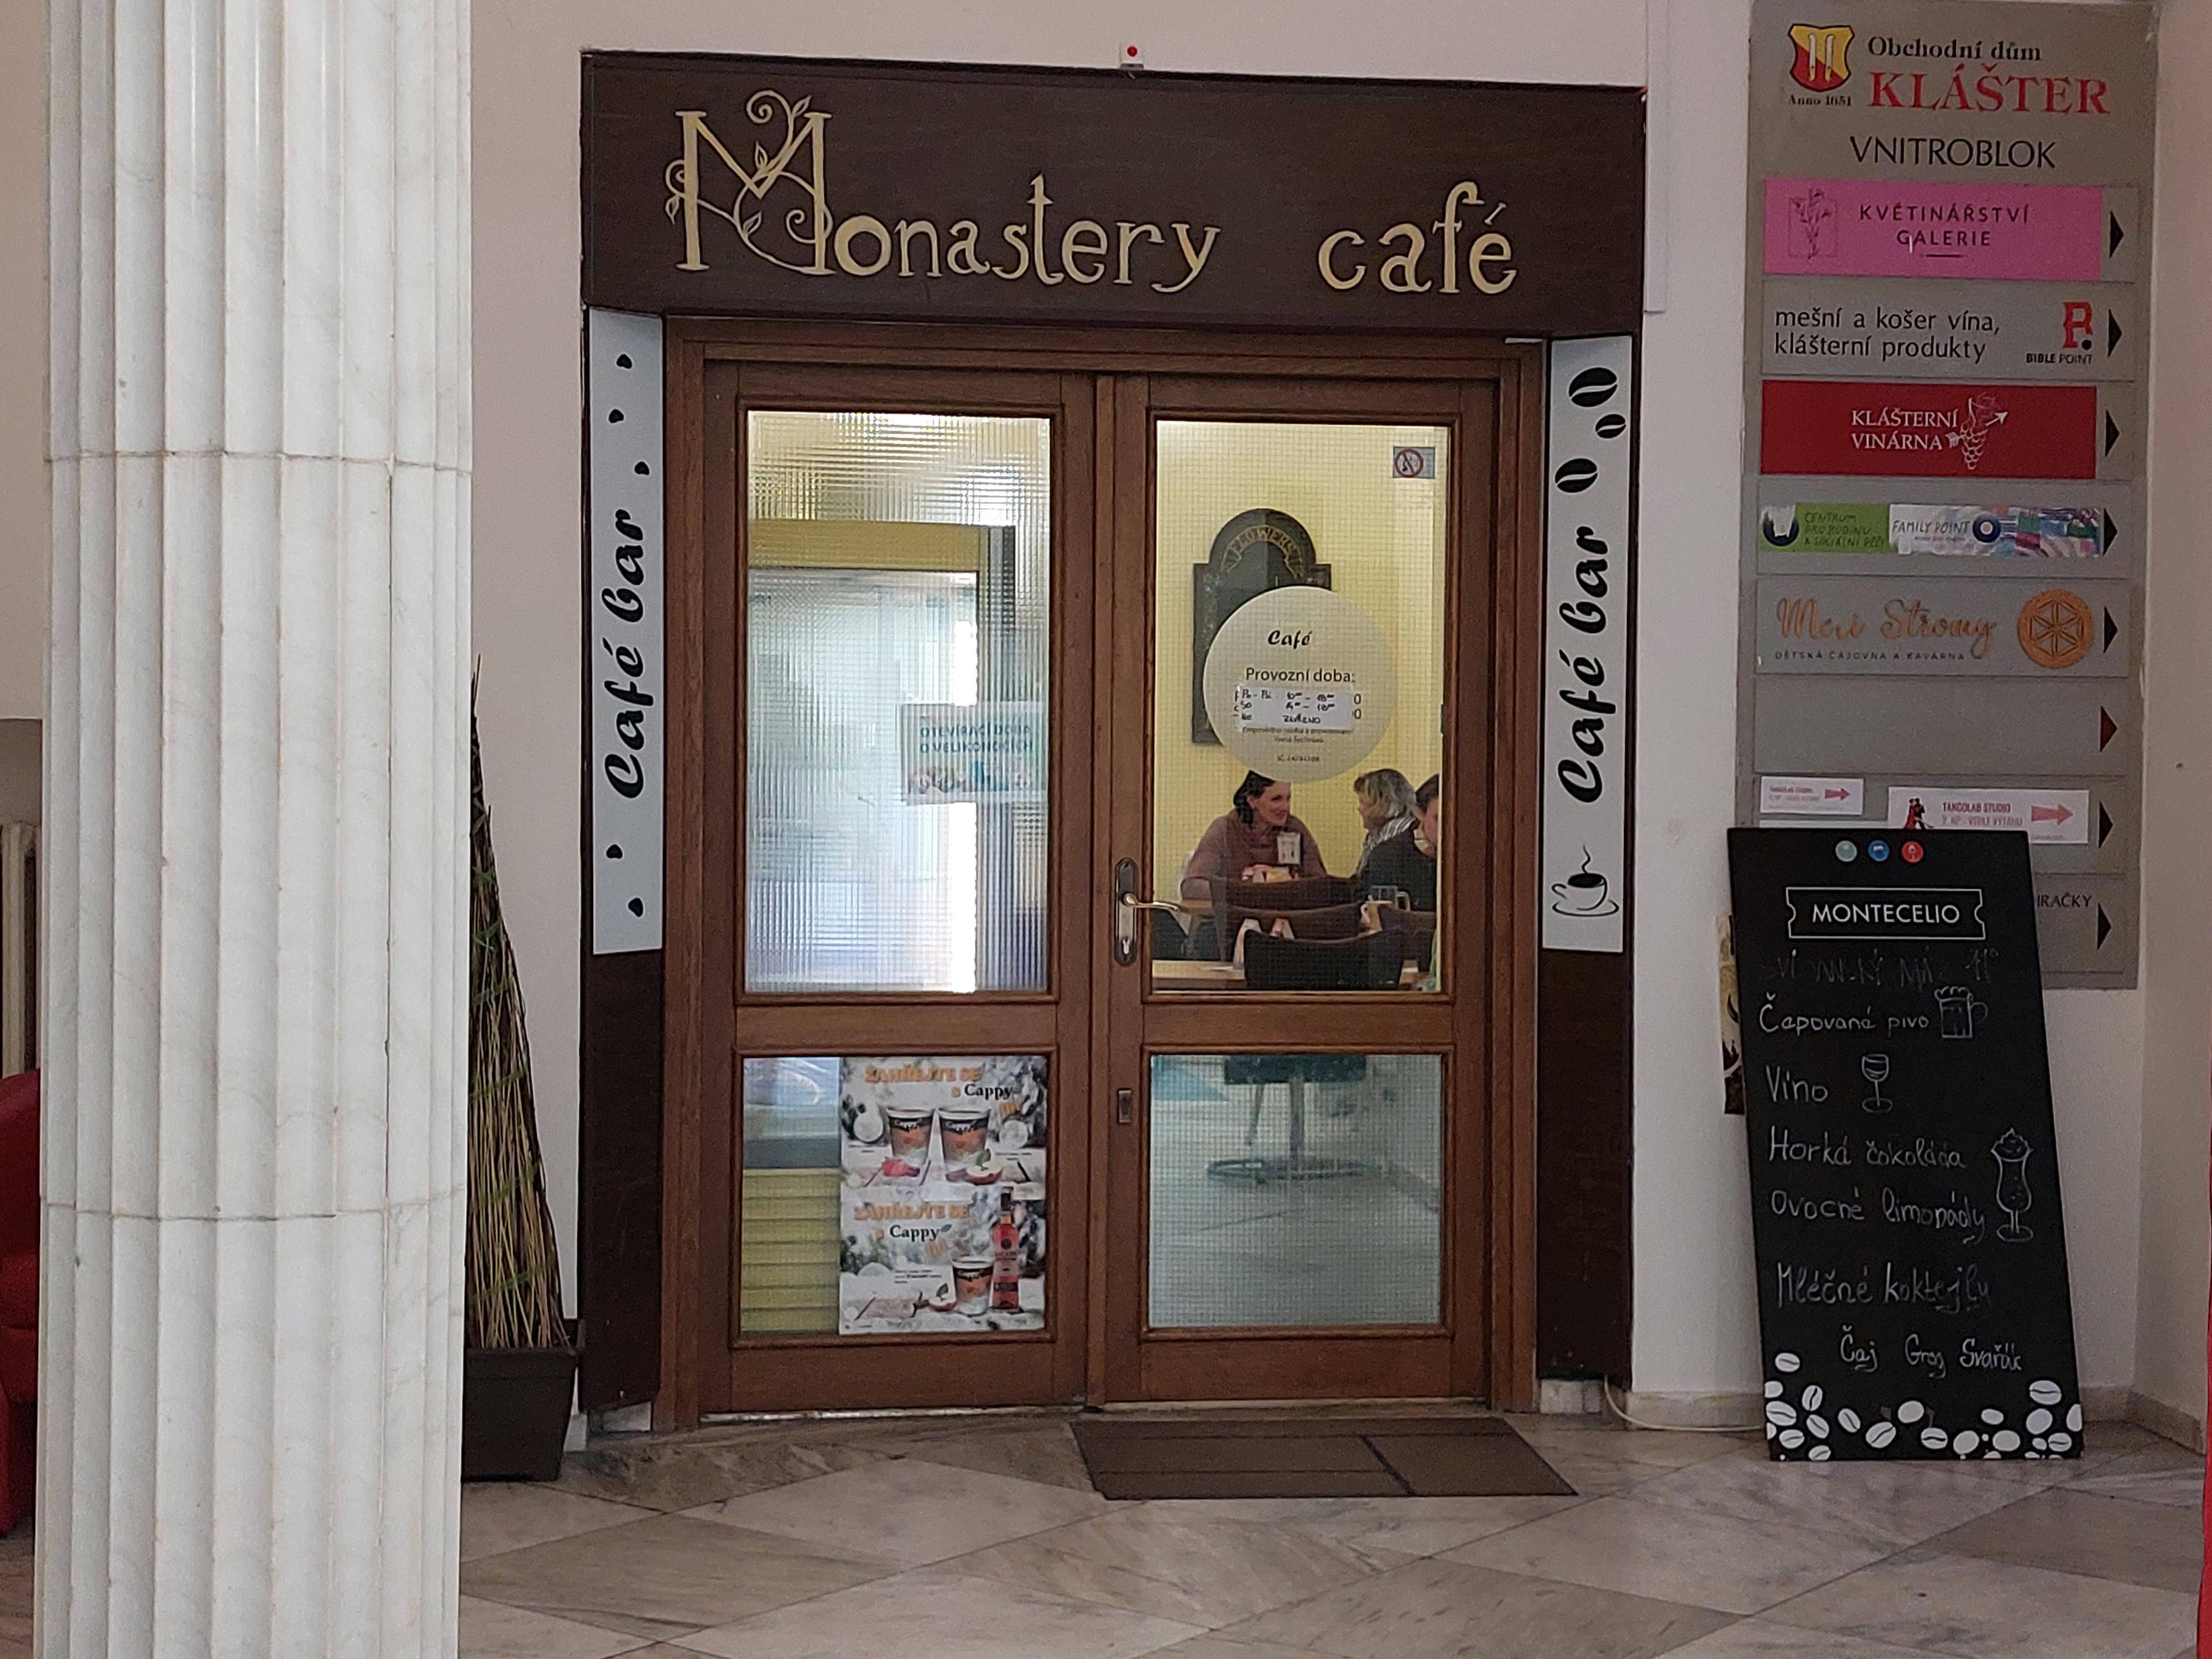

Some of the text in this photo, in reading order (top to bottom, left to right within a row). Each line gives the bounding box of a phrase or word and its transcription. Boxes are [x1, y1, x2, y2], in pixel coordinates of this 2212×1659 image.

[1867, 35, 2041, 61] Obchodní dům
[1788, 94, 1821, 106] Anno
[1867, 62, 2110, 114] KLÁŠTER
[1850, 136, 2056, 168] VNITROBLOK
[665, 90, 1517, 294] Monastery café
[1860, 202, 2029, 225] KVĚTINÁŘSTVÍ
[1897, 230, 1991, 247] GALERIE
[1775, 306, 2000, 335] mešní a košer vína,
[1775, 333, 1986, 363] klášterní produkty
[2026, 353, 2093, 364] BIBLE POINT
[1851, 408, 1958, 428] KLÁŠTERNÍ
[1852, 431, 1943, 451] VINÁRNA
[1892, 520, 1970, 534] FAMILY POINT
[1267, 629, 1313, 650] Café
[601, 509, 654, 799] Café bar
[1557, 526, 1616, 804] Café bar
[1245, 667, 1355, 683] Provozní doba:
[1812, 904, 1960, 924] MONTECELIO
[1759, 992, 1929, 1038] Čapované pivo
[964, 1083, 1013, 1100] Cappy
[1769, 1125, 1966, 1168] Horká čokoláda
[1771, 1186, 1986, 1244] Ovocné limonády
[889, 1224, 941, 1242] Cappy
[1777, 1261, 1873, 1308] Mléčné
[1840, 1324, 1878, 1373] Čaj
